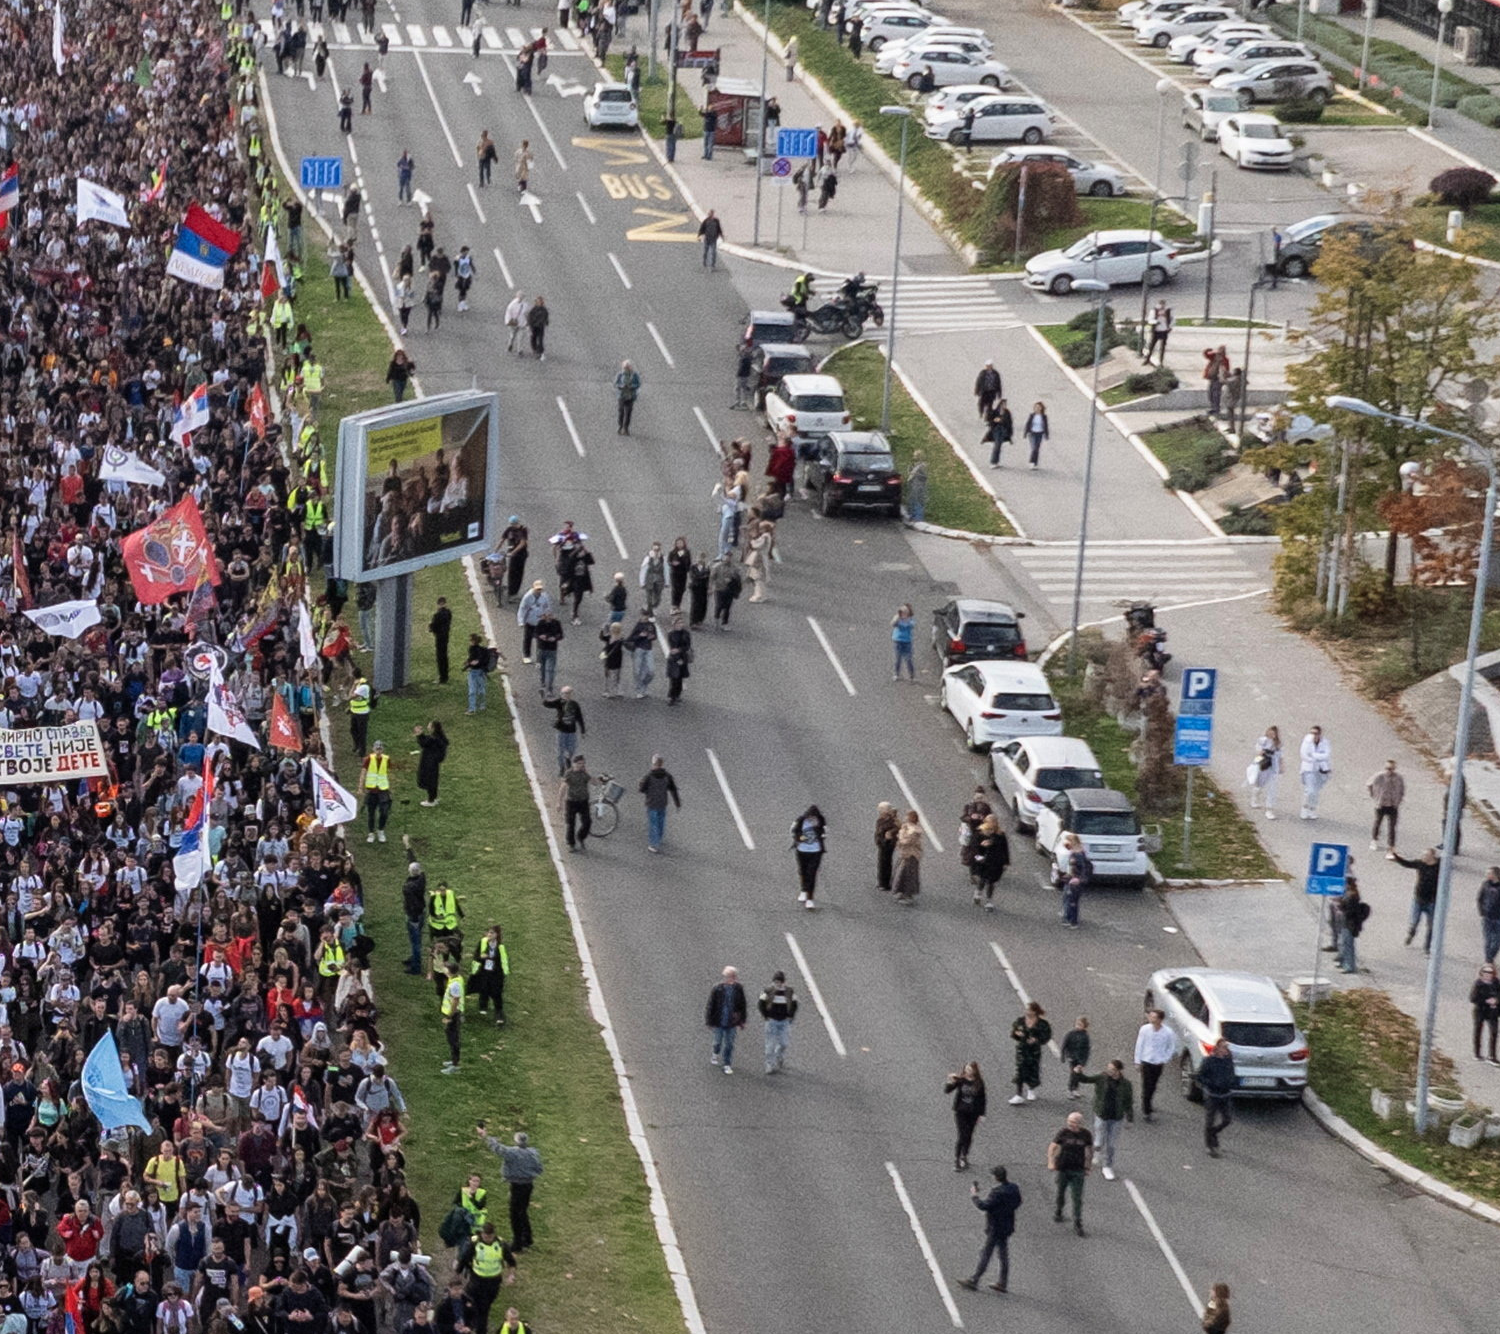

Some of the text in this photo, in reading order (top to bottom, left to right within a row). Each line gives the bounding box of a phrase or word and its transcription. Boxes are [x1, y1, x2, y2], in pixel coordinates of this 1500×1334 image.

[1188, 672, 1210, 697] P
[50, 738, 97, 755] НИЈЕ
[56, 752, 101, 772] ДЕТЕ
[1317, 848, 1340, 872] P
